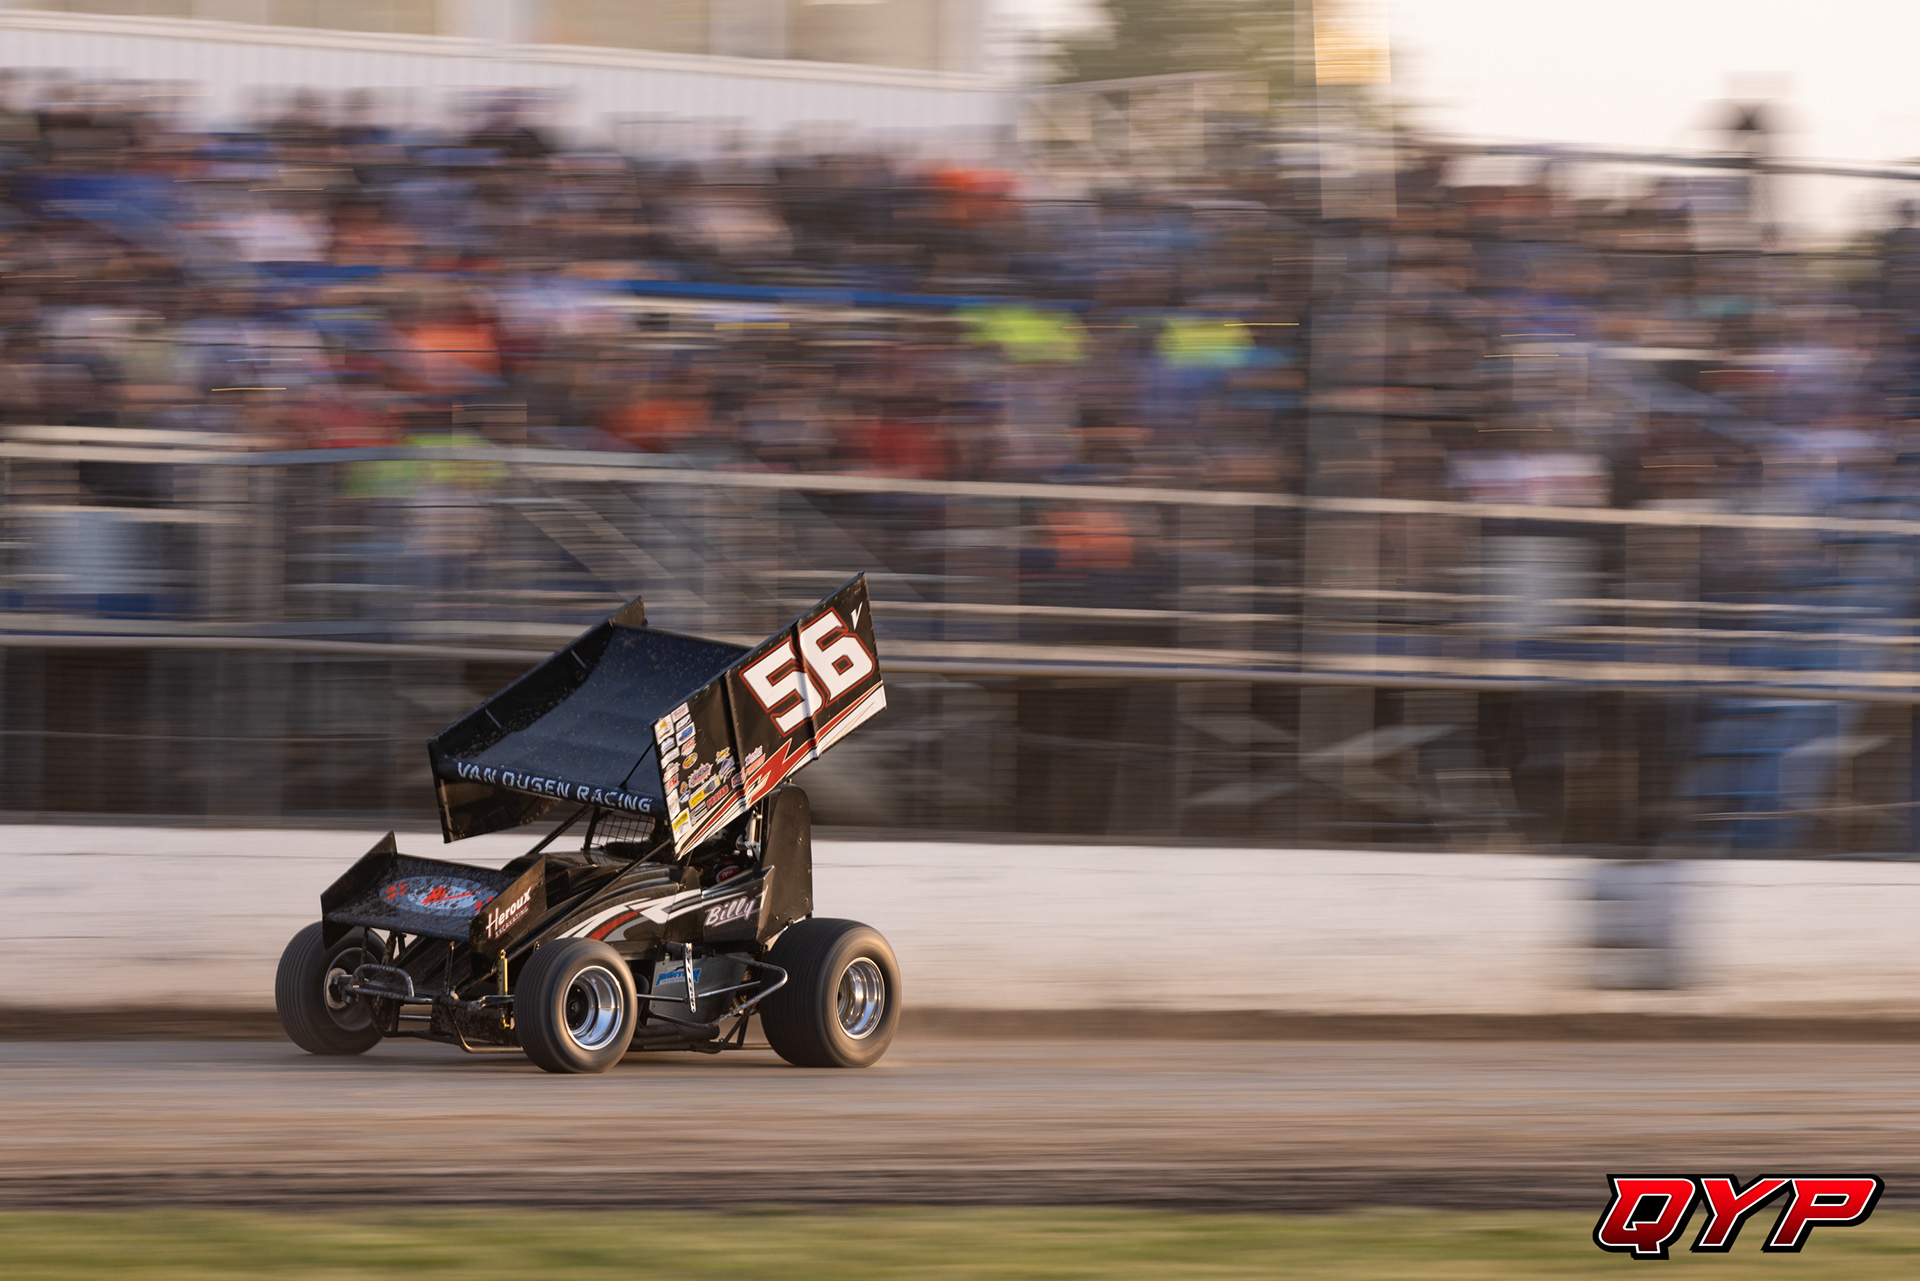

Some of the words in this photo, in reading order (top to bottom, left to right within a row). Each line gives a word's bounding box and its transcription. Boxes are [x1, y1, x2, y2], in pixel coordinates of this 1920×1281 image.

[739, 606, 876, 738] 56
[457, 761, 498, 785] VAN
[501, 770, 571, 799] DUSEN
[576, 785, 653, 813] RACING
[485, 886, 533, 940] Heroux
[494, 905, 530, 939] EXCAVATING
[704, 896, 757, 927] Billy
